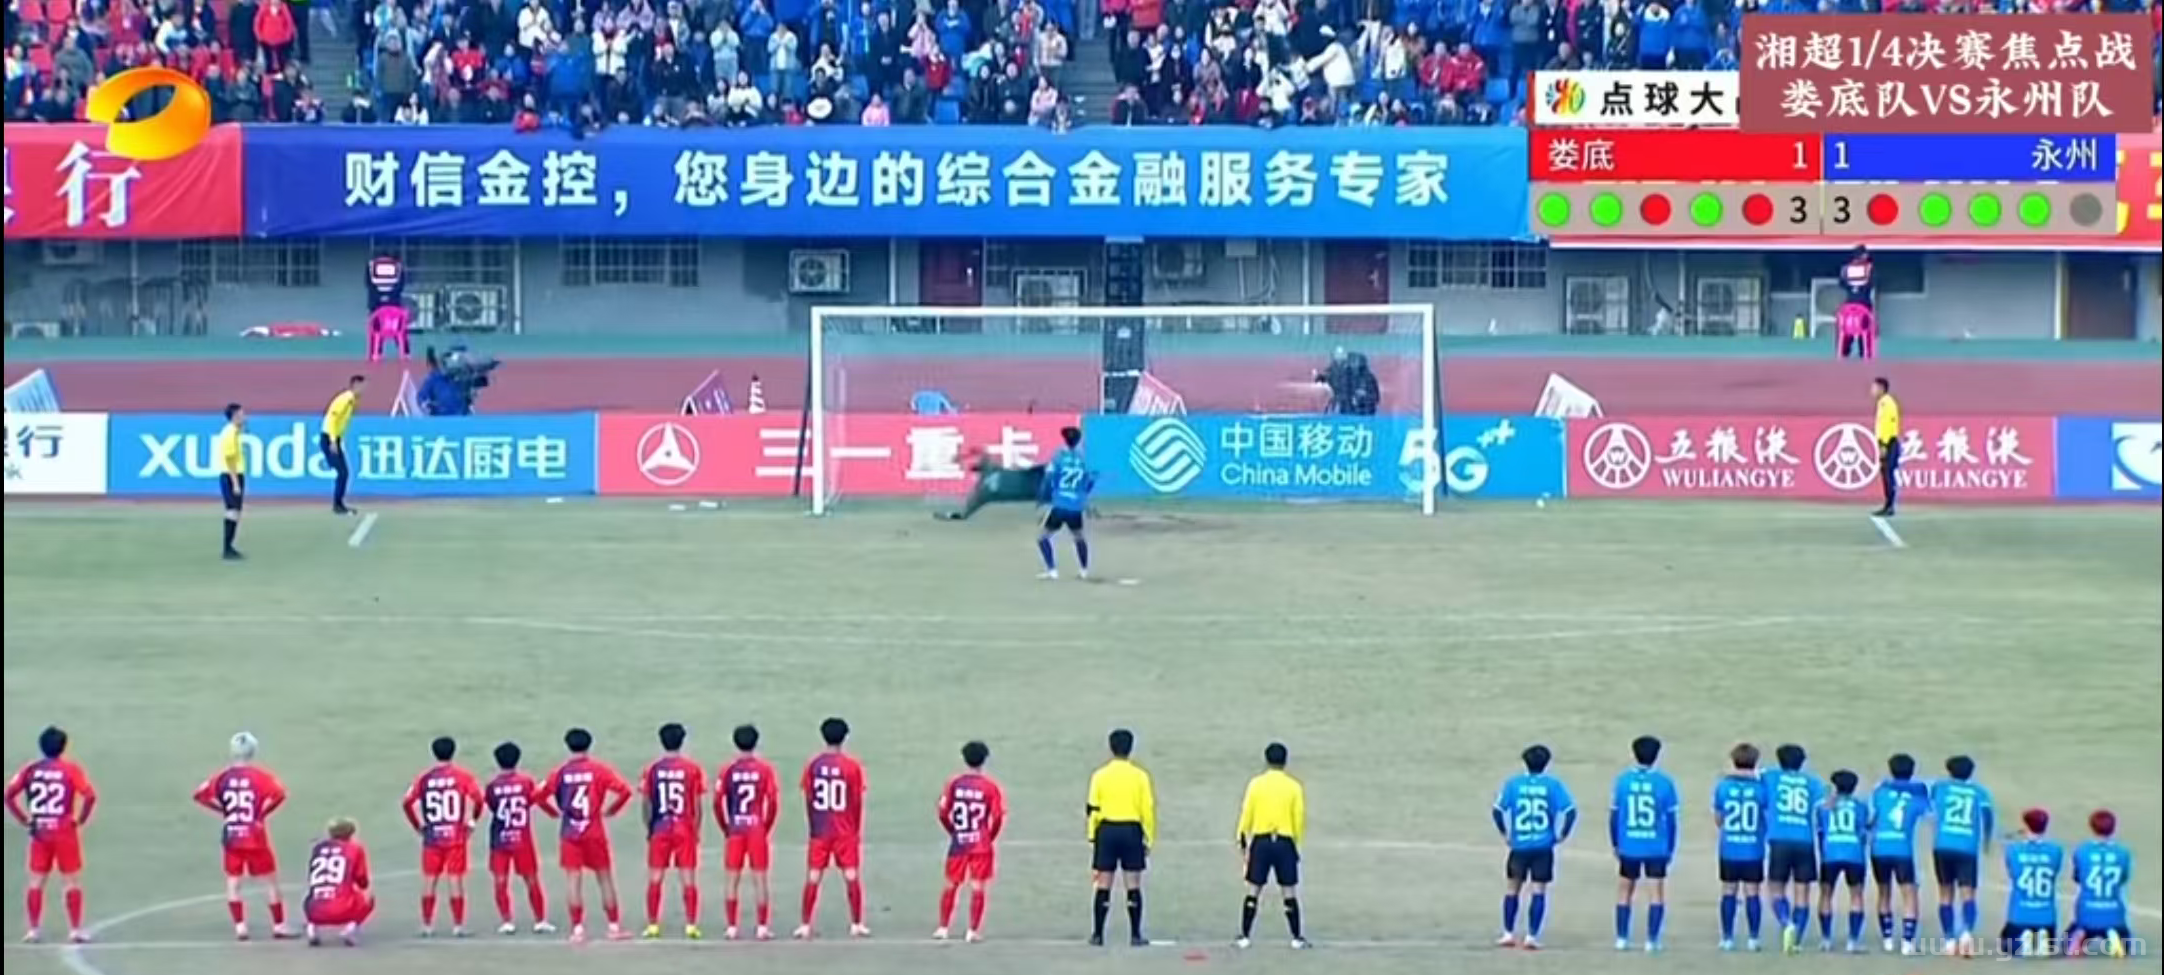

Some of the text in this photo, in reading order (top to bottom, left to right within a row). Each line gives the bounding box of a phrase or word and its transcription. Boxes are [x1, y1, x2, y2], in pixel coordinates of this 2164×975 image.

[345, 149, 1450, 217] 财信金控，您身边的综合金融服务专家
[755, 426, 1039, 480] 三一重卡
[1221, 421, 1373, 460] 中国移动
[358, 434, 566, 480] 迅达厨电
[1060, 467, 1084, 488] 27
[1221, 462, 1372, 486] China Mobile
[1662, 468, 1795, 488] WULIANGYE
[1893, 469, 2027, 489] WULIANGYE
[29, 782, 66, 815] 22
[223, 791, 255, 823] 25
[426, 789, 460, 822] 50
[571, 785, 590, 817] 4
[657, 782, 685, 814] 15
[813, 779, 847, 811] 30
[1777, 784, 1809, 815] 36
[1945, 795, 1974, 825] 21
[953, 802, 986, 830] 37
[1515, 799, 1549, 831] 25
[1627, 796, 1655, 828] 15
[1724, 801, 1758, 832] 20
[310, 856, 346, 886] 29
[2018, 868, 2053, 898] 46
[2086, 868, 2121, 898] 47
